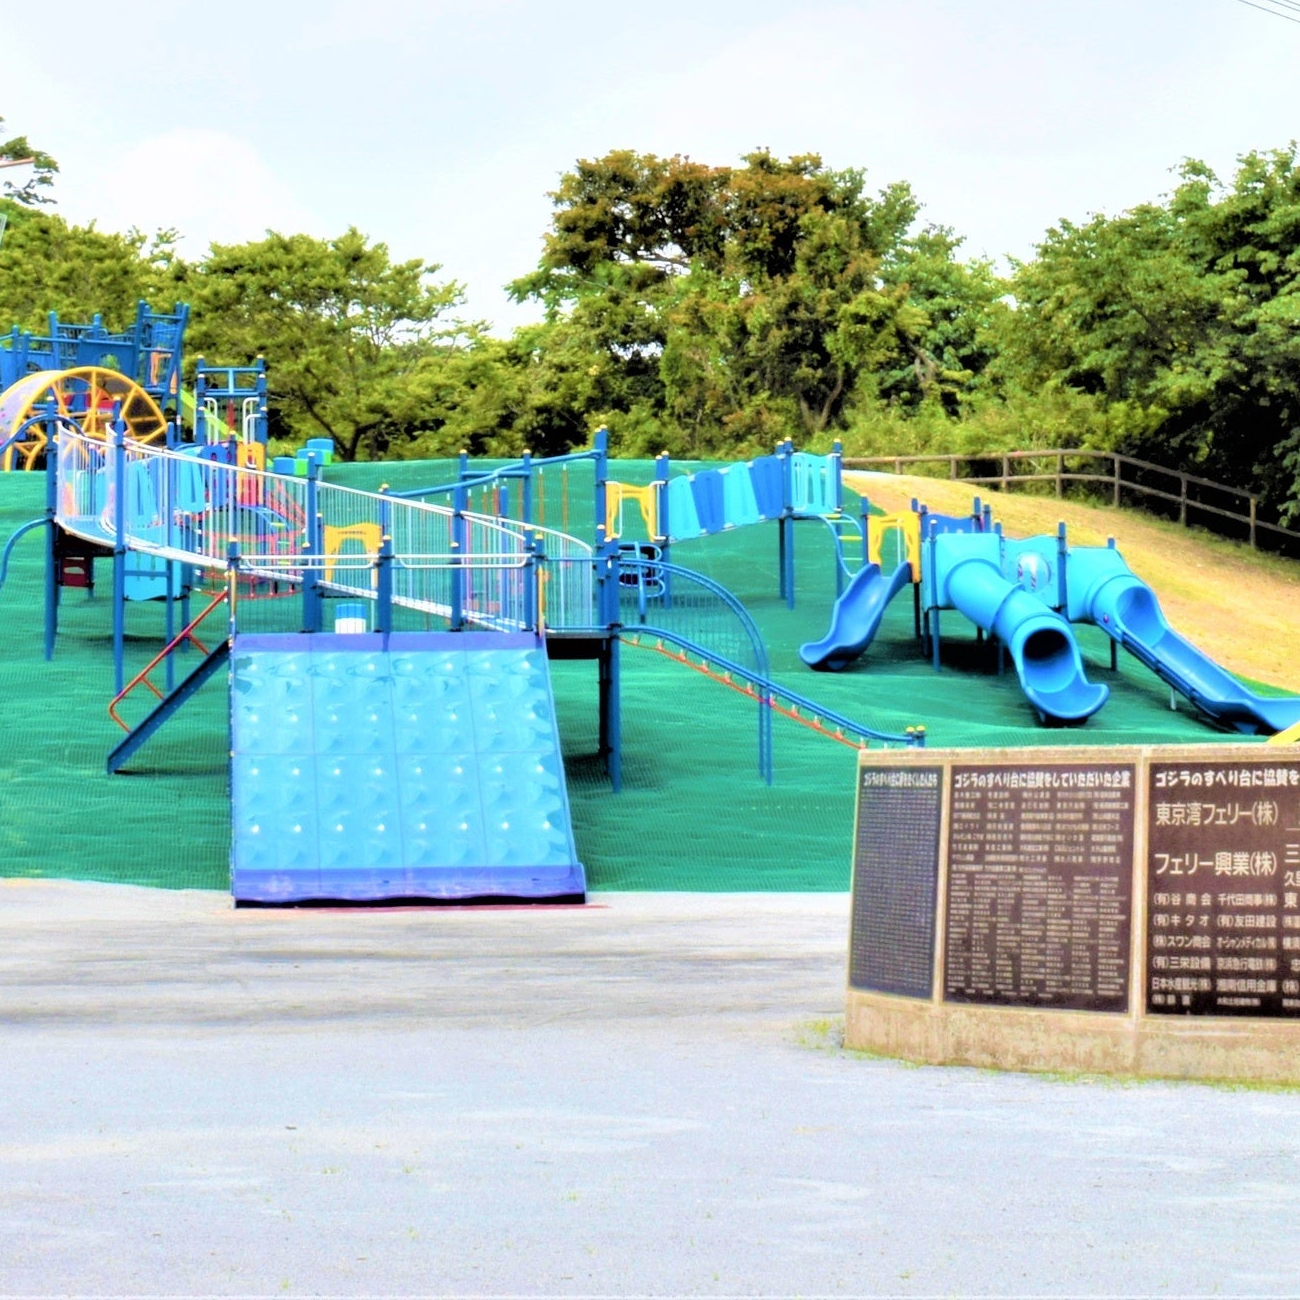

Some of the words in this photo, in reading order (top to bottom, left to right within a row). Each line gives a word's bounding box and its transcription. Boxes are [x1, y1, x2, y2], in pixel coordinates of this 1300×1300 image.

[1155, 801, 1278, 827] 東京湾フェリー(株)
[1154, 851, 1278, 876] フェリー興業(株)
